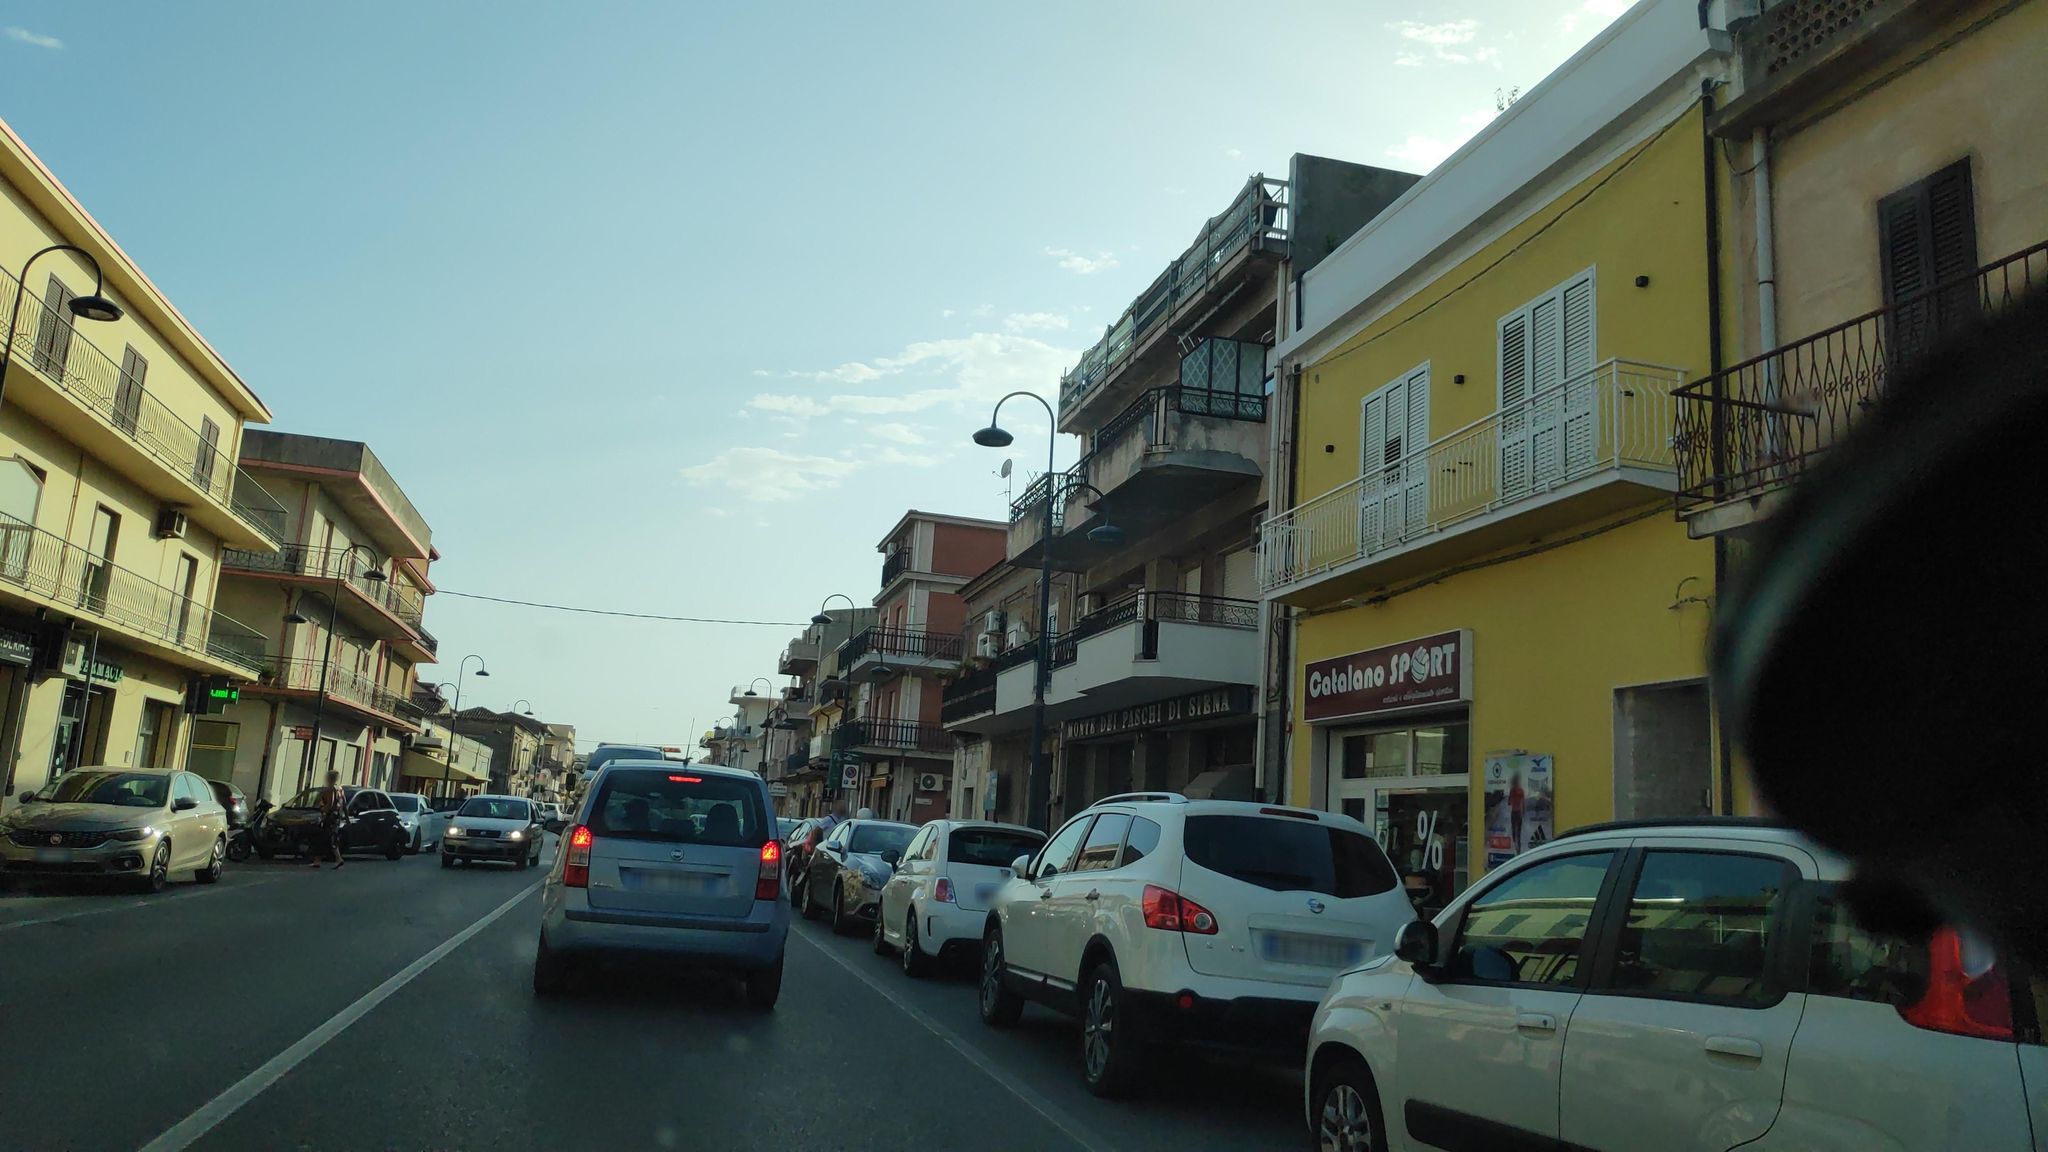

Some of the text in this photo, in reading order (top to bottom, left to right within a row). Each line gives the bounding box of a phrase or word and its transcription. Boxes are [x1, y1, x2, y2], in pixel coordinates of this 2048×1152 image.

[1309, 664, 1385, 698] Catalano
[1389, 643, 1455, 685] SPORT
[1067, 691, 1230, 738] MONTE DEI PASCHI DI SIENA
[1417, 810, 1443, 871] %
